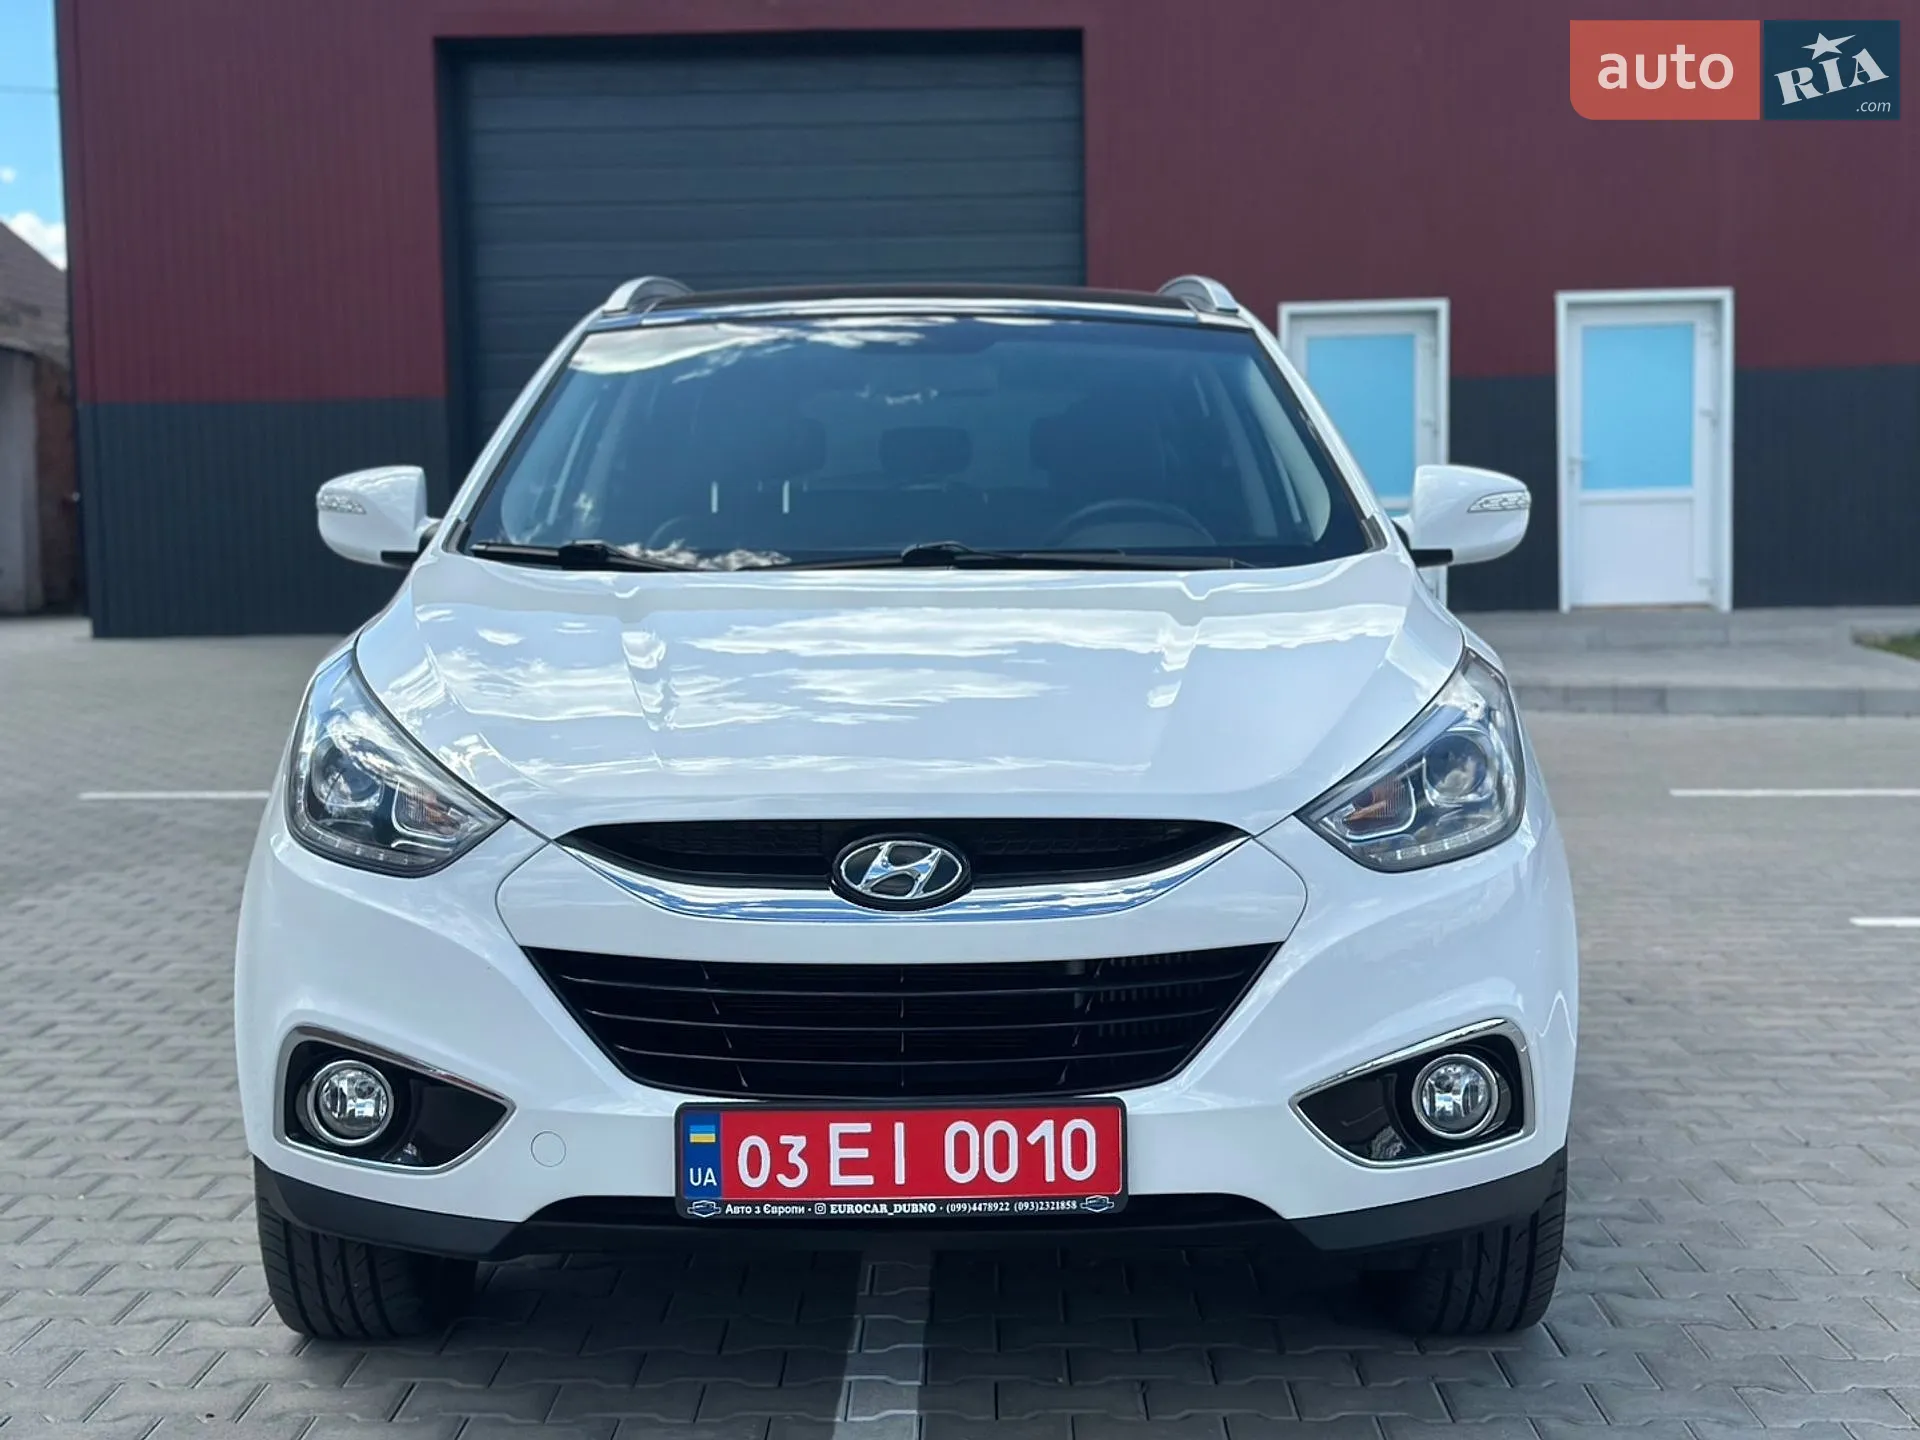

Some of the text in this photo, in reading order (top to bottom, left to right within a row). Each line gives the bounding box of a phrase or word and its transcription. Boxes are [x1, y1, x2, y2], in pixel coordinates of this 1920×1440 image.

[737, 1118, 1097, 1188] 03 EI 0010
[689, 1167, 718, 1187] UA
[725, 1203, 752, 1214] Авто
[763, 1203, 805, 1217] Європи
[829, 1202, 937, 1216] EUROCAR_DUBNO
